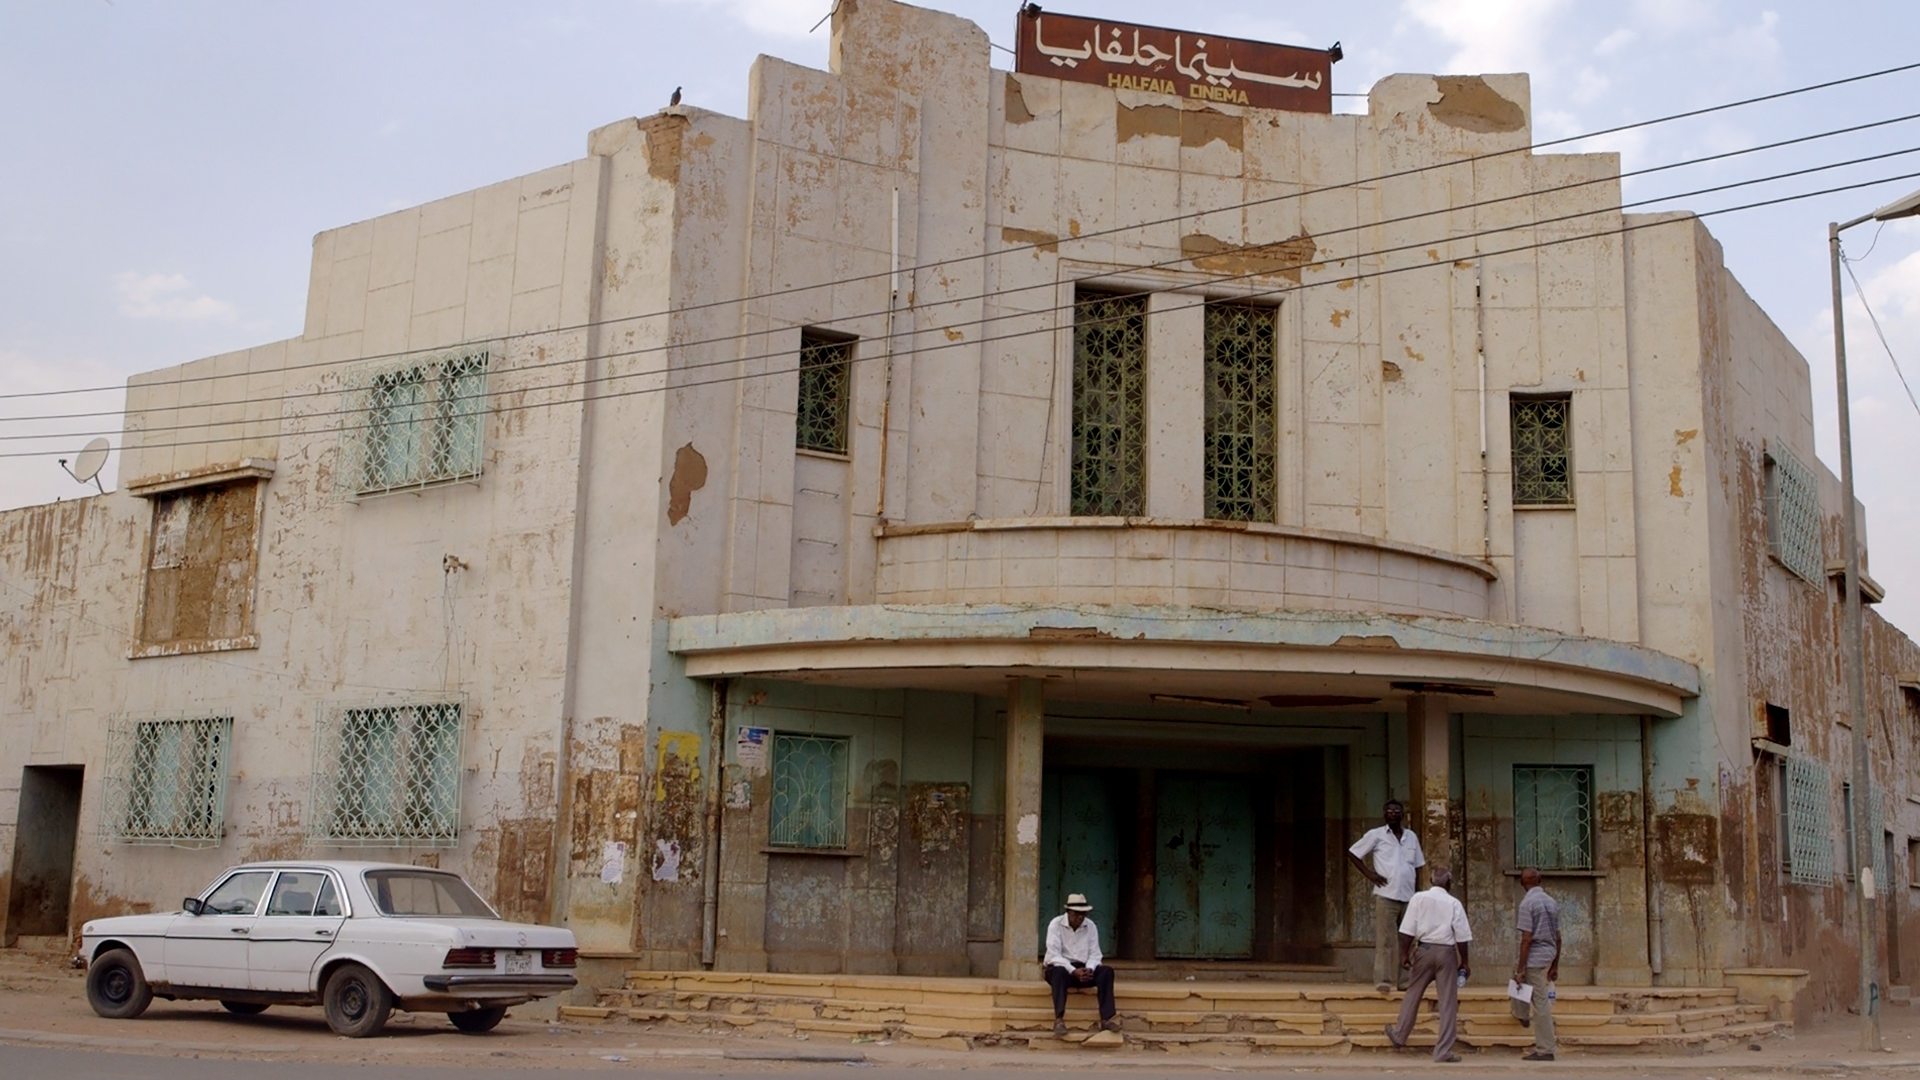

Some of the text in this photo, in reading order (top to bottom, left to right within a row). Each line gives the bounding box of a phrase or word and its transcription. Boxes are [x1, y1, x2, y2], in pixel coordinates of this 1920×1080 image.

[1035, 17, 1322, 90] سينما حلفايا
[1108, 73, 1249, 105] HALFAIA CINEMA
